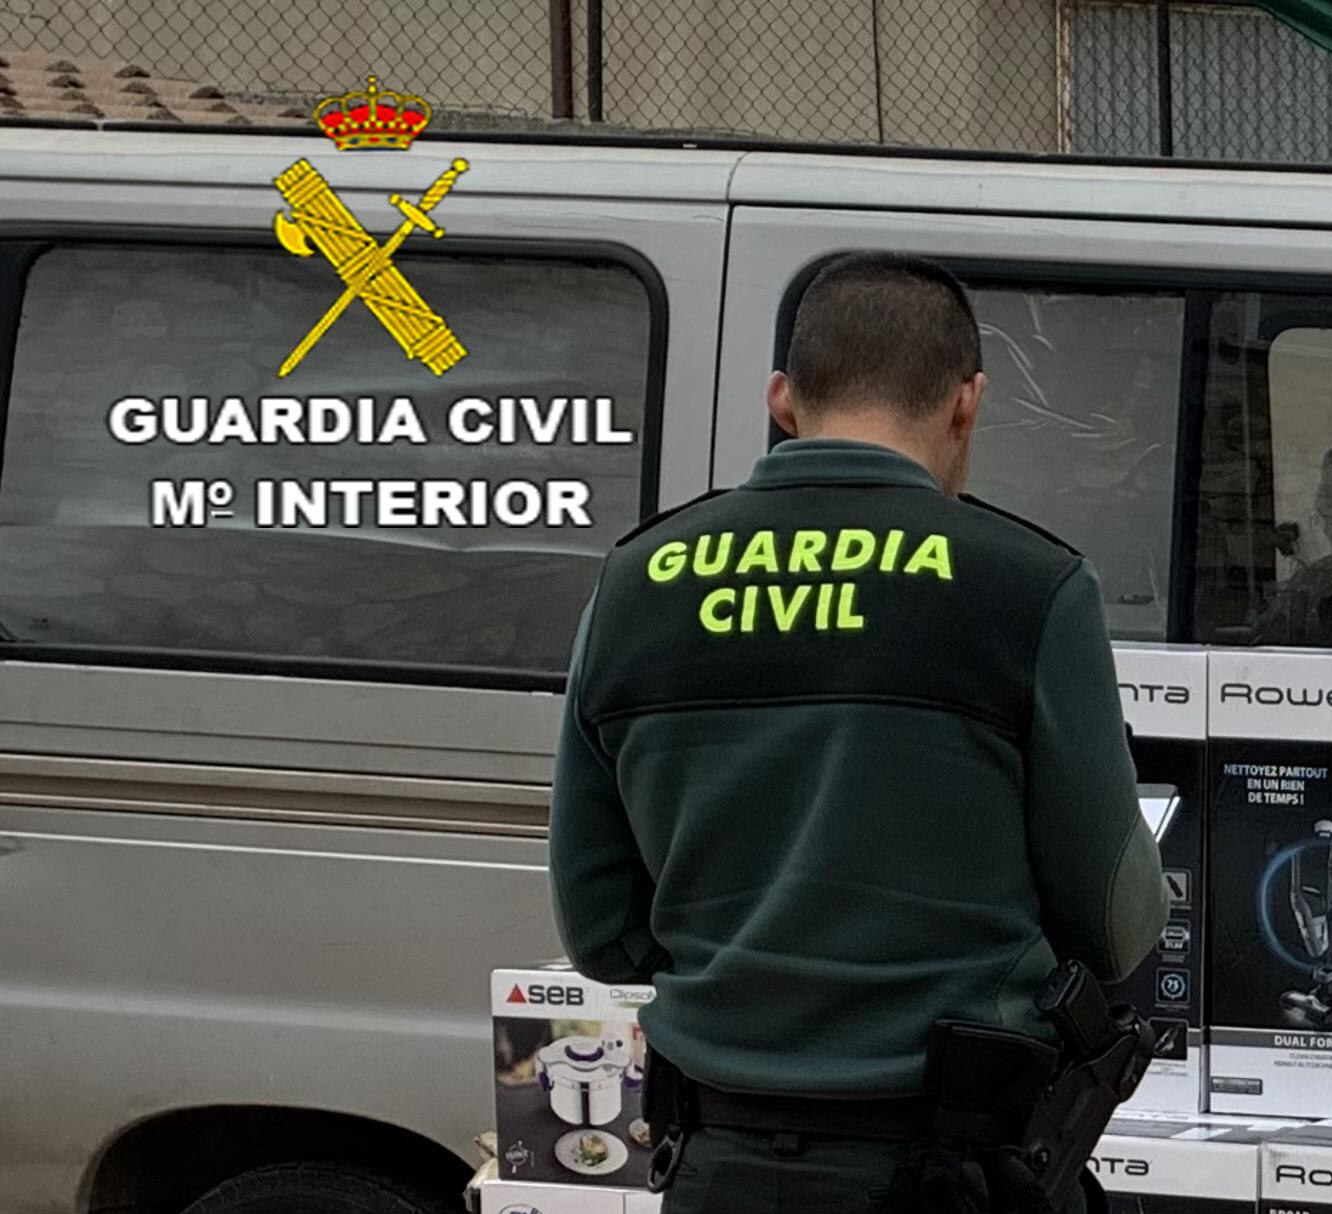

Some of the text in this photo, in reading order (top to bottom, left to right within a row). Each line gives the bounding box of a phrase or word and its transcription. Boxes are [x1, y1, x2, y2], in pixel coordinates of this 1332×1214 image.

[647, 528, 953, 582] GUARDIA
[700, 582, 864, 633] CIVIL
[1224, 764, 1329, 778] NETTOYEZ PARTOUT
[1248, 792, 1262, 803] DE
[1274, 1035, 1307, 1047] DUAL
